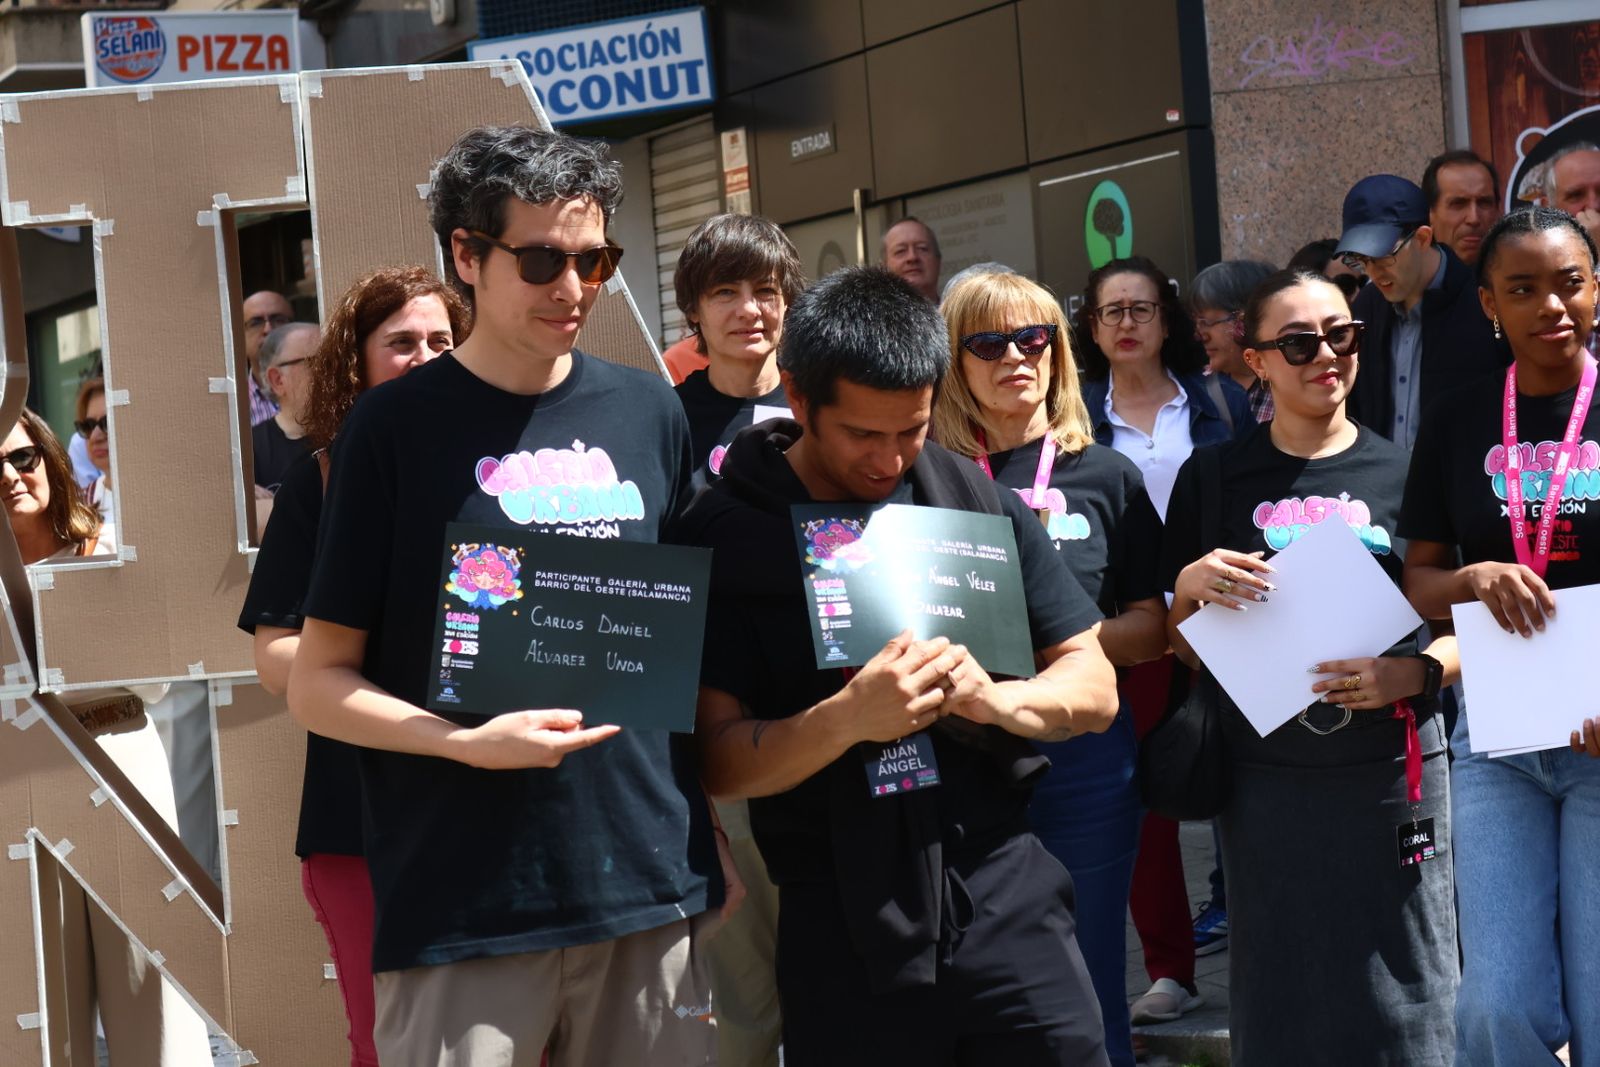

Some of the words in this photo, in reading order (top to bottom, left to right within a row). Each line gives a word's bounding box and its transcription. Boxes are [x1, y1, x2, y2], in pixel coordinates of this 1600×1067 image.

[98, 30, 160, 59] SELANI
[177, 34, 290, 72] PIZZA
[500, 22, 682, 78] SOCIACIÓN
[791, 132, 831, 157] ENTRADA
[1508, 396, 1516, 409] del
[1574, 386, 1590, 403] Soy
[1574, 403, 1584, 418] del
[1508, 411, 1516, 437] Barrio
[1546, 484, 1560, 511] Barrio
[1511, 504, 1520, 519] del
[1531, 500, 1587, 517] EIÓN
[1542, 511, 1551, 528] del
[1515, 521, 1524, 539] Soy
[977, 544, 1007, 555] URBANA
[1539, 530, 1548, 555] oeste
[934, 547, 958, 556] OESTE
[960, 549, 1008, 563] (SALAMANCA)
[534, 579, 570, 590] BARRIO
[574, 583, 591, 593] DEL
[595, 585, 626, 596] OESTE
[628, 589, 691, 603] (SALAMANCA)
[535, 571, 601, 585] PARTICIPANTE
[608, 578, 648, 590] GALERÍA
[654, 583, 691, 594] URBANA
[530, 605, 584, 630] CARLOS
[524, 639, 586, 666] ÁLVAREZ
[606, 651, 644, 674] UNDA
[880, 743, 918, 762] JUAN
[878, 757, 927, 776] ÁNGEL
[1403, 832, 1430, 848] CORAL
